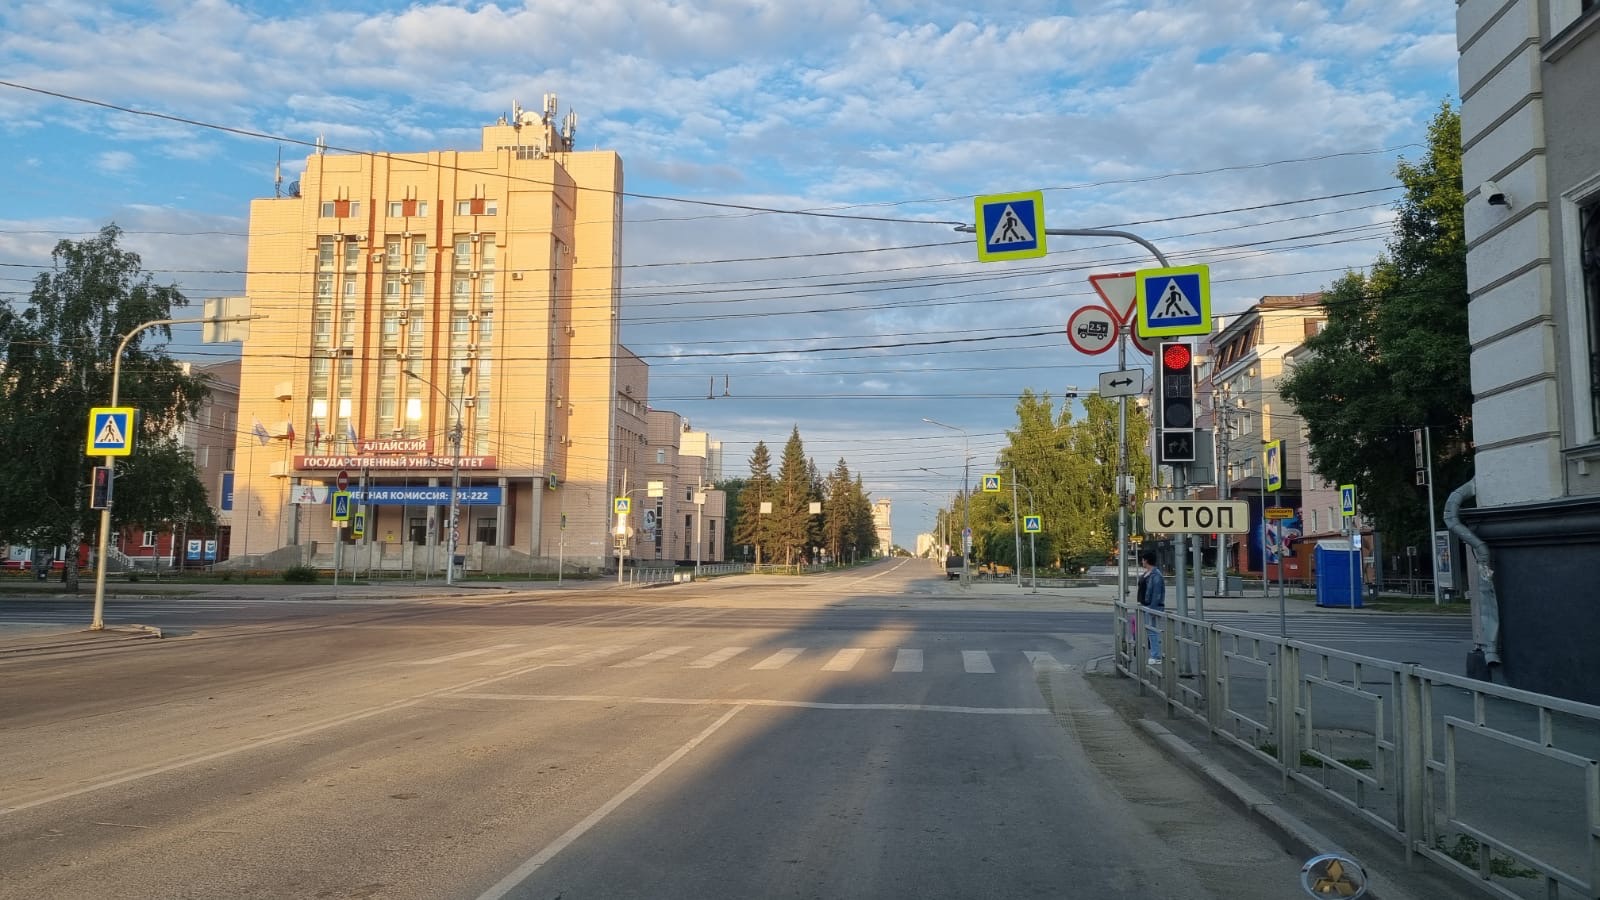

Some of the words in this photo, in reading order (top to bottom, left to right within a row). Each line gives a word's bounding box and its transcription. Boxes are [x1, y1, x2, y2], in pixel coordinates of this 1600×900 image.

[363, 440, 426, 451] АЛТАЙСКИЙ
[303, 456, 407, 467] ГОСУДАРСТВЕННЫЙ
[390, 491, 449, 500] КОМИССИЯ:
[456, 491, 489, 500] 91-222
[1158, 506, 1233, 528] СТОП
